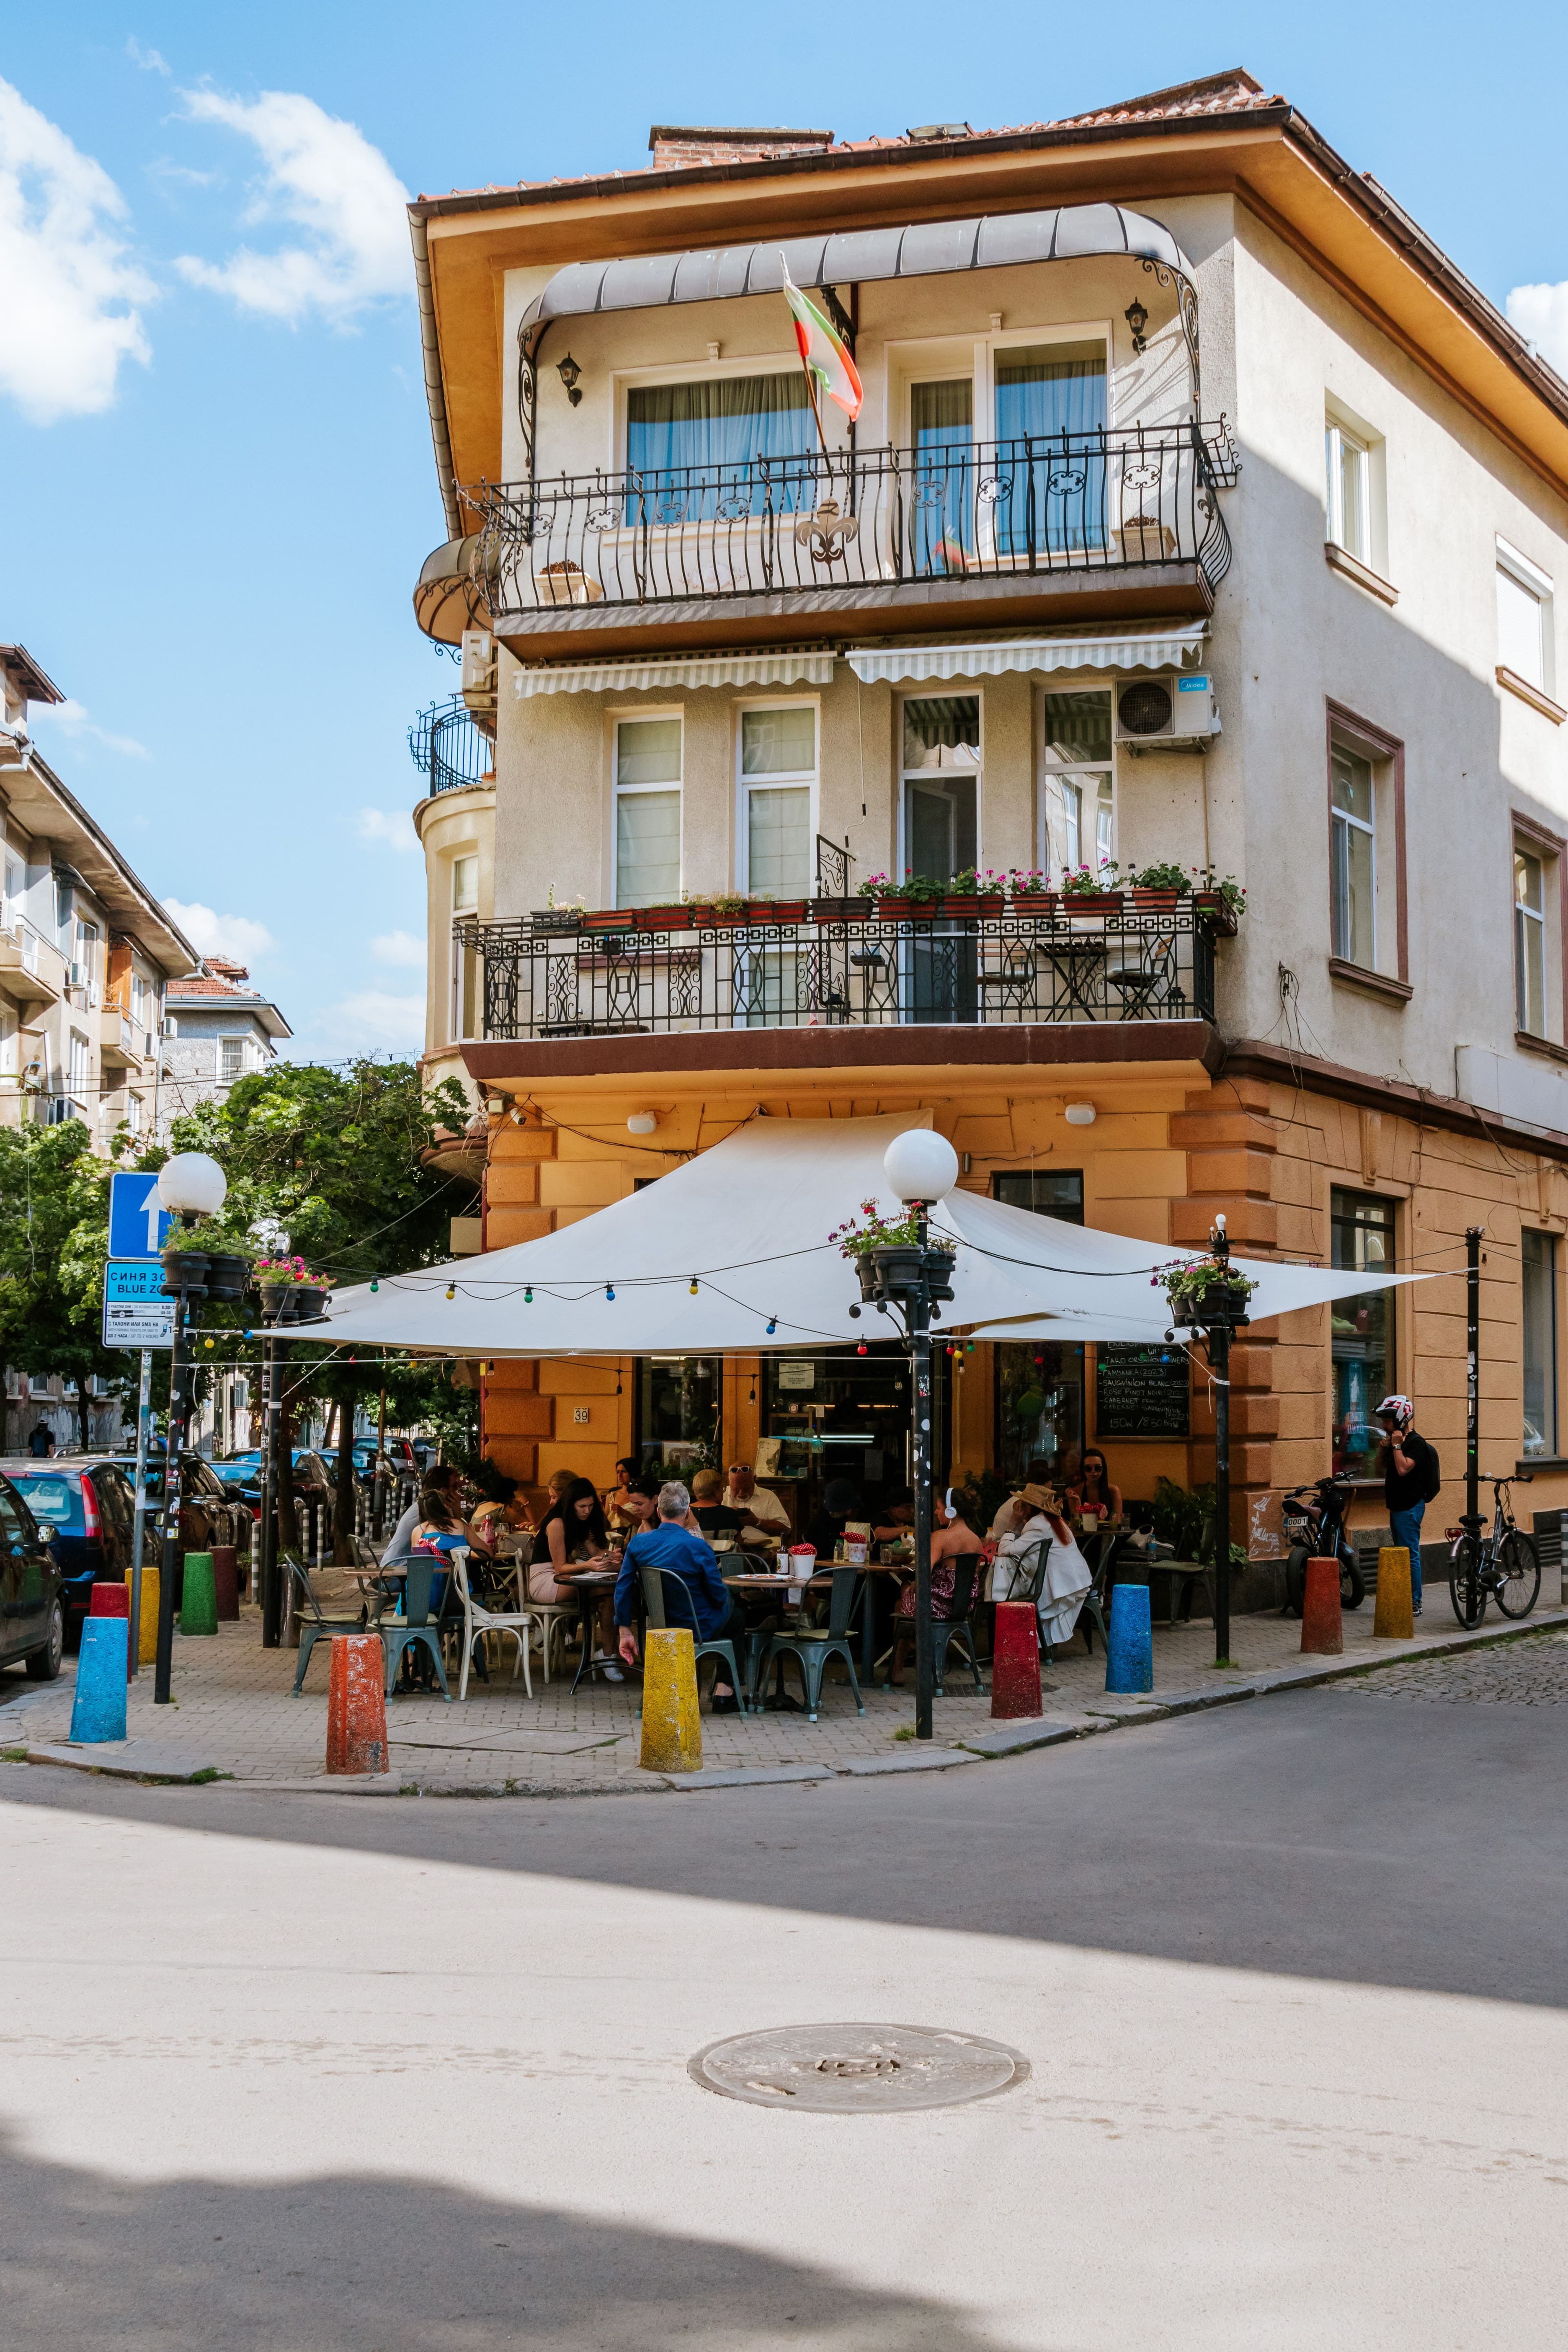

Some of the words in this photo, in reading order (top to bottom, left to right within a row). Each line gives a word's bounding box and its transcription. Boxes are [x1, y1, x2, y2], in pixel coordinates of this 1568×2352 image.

[111, 1272, 146, 1281] СИНЯ
[151, 1273, 166, 1281] ЗО
[118, 1284, 147, 1293] BLUE
[575, 1410, 587, 1420] 39
